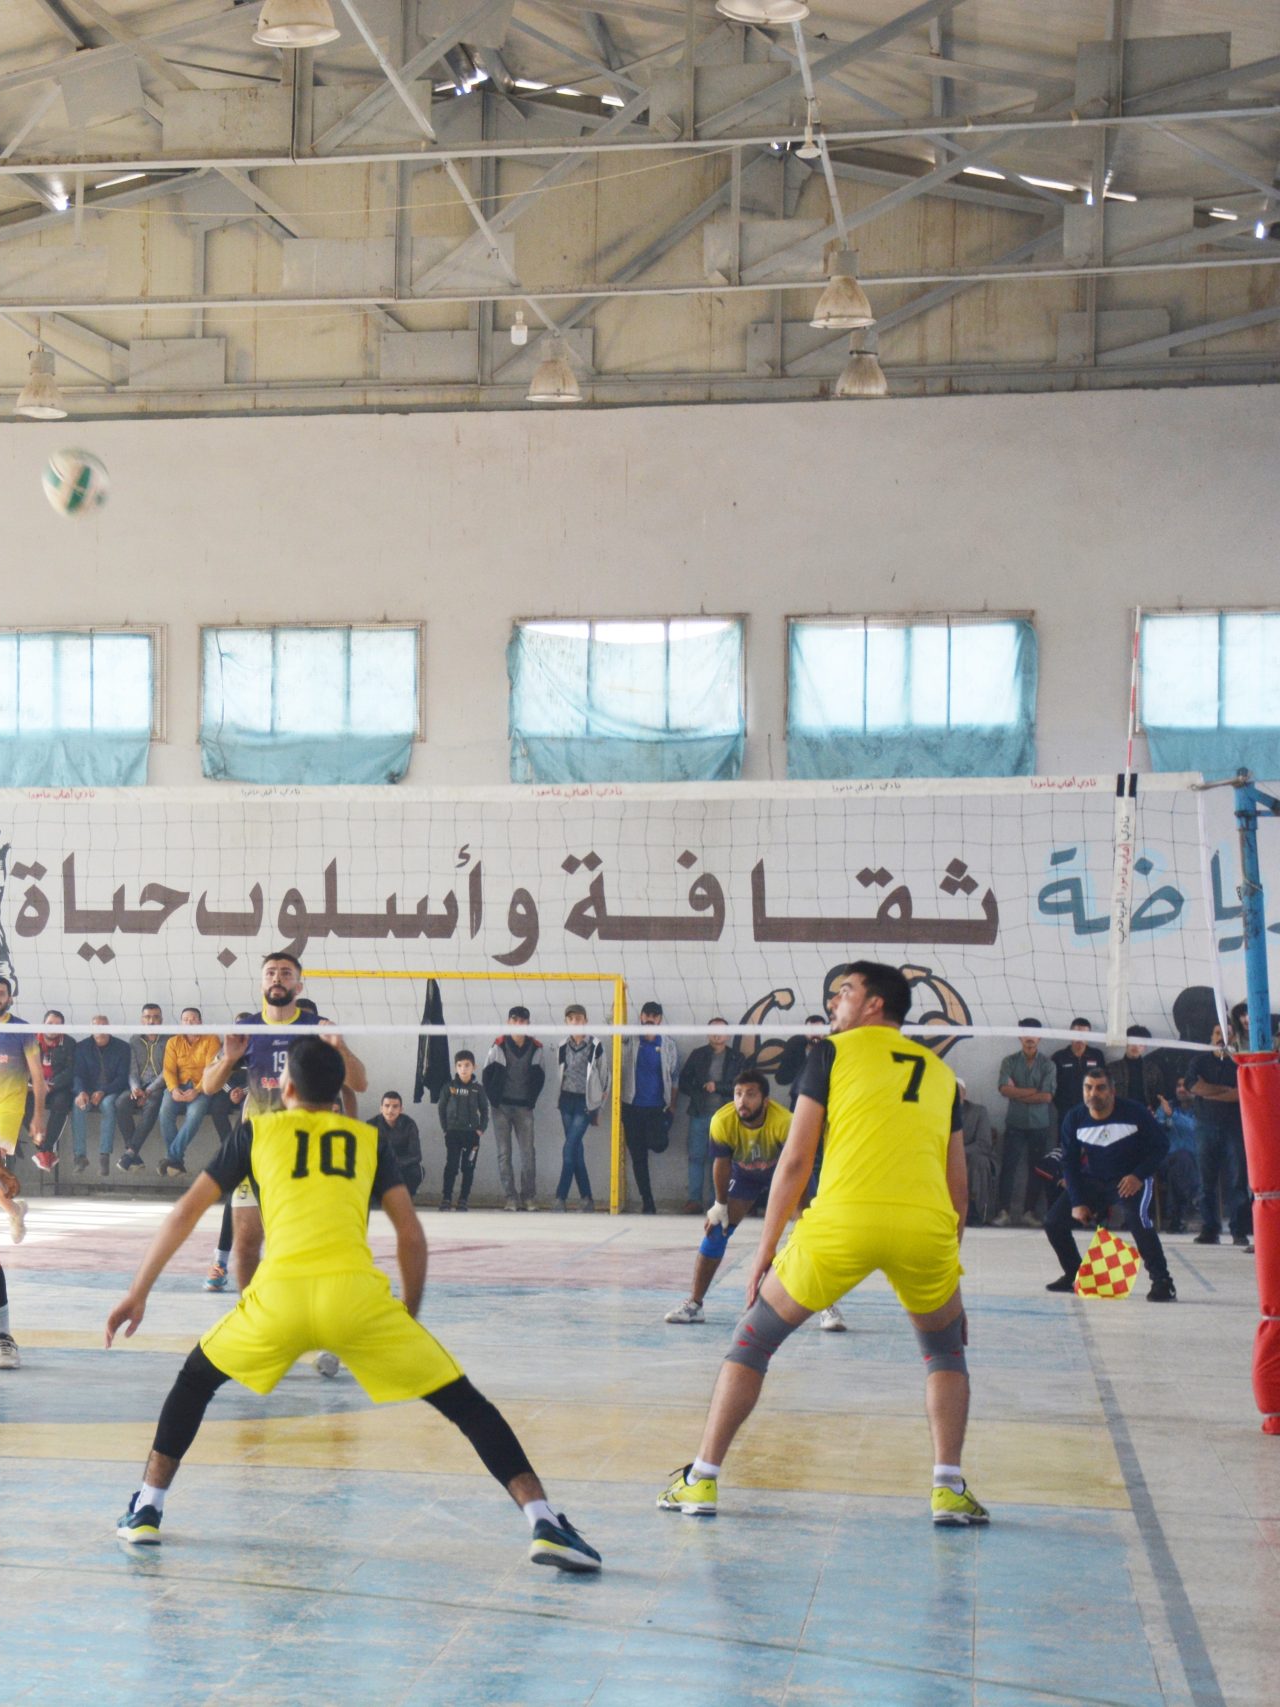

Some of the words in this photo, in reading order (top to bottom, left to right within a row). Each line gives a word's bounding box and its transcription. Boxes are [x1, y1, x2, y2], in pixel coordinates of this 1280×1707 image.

[10, 851, 190, 965] حياة
[195, 843, 540, 969] وأسلوب
[561, 849, 999, 946] ثقافة
[891, 1050, 926, 1103] 7
[292, 1130, 357, 1180] 10
